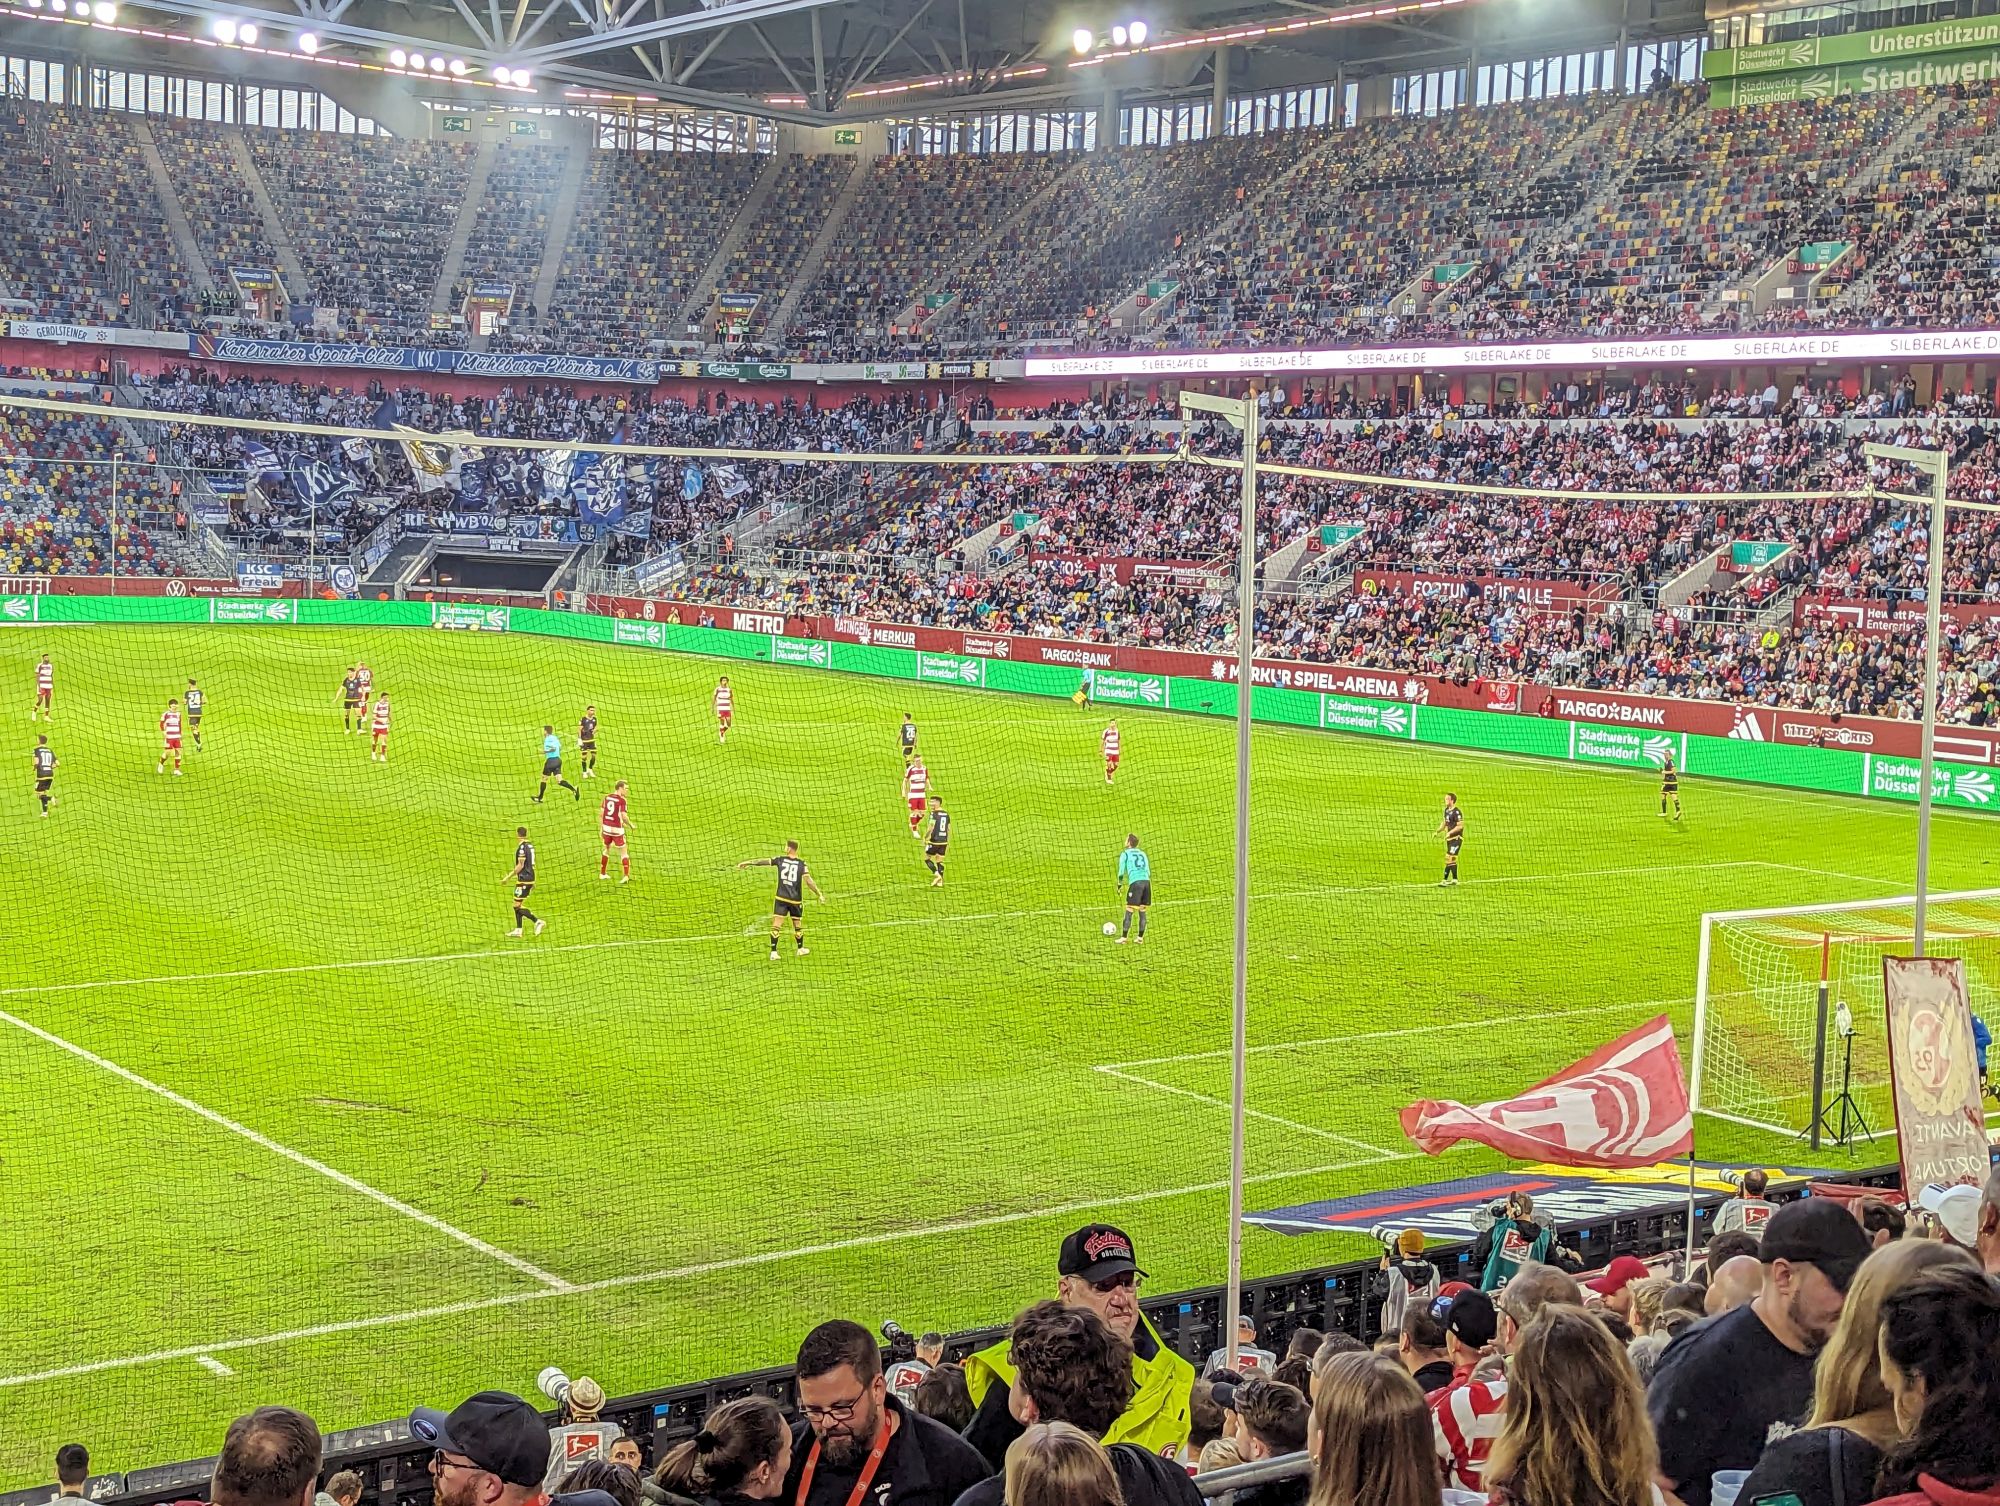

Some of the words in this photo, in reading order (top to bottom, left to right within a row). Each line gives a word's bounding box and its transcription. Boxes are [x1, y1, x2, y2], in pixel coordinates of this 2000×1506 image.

[1869, 25, 2000, 54] Unterstützun
[1739, 47, 1786, 60] Stadtwerke
[1739, 57, 1785, 70] Düsseldorf
[1740, 77, 1797, 93] Stadtwerke
[1739, 90, 1797, 106] Düsseldorf
[36, 325, 88, 340] GEROLSTEINER
[217, 338, 306, 361] Karlsruher
[309, 343, 405, 365] Sport-Club
[1890, 336, 2000, 352] SILBERLAKE.D
[457, 353, 601, 376] Mühlburg-Phönix
[603, 359, 632, 377] e.V.
[707, 363, 740, 377] Carlsberg
[759, 364, 788, 378] Carlsberg
[1003, 525, 1012, 535] 23
[1310, 539, 1320, 550] 25
[246, 564, 273, 574] KSC
[1719, 557, 1730, 569] 27
[241, 576, 277, 587] Freak
[1867, 607, 1906, 620] Hewett
[733, 612, 784, 635] METRO
[873, 629, 916, 645] MERKUR
[922, 667, 959, 680] Düsseldorf
[1096, 674, 1138, 688] Stadtwerke
[1229, 664, 1291, 687] MRKUR
[1293, 669, 1399, 697] SPIEL-ARENA
[1096, 685, 1138, 699] Düsseldorf
[1328, 699, 1379, 715] Stadtwerke
[1328, 711, 1378, 729] Düsseldorf
[1578, 727, 1640, 746] Stadtwerke
[1578, 741, 1640, 760] Düsseldorf
[40, 751, 51, 767] 10
[1875, 760, 1951, 782] Stadtwke
[607, 800, 615, 816] 9
[1133, 854, 1146, 868] 23
[780, 863, 798, 882] 28
